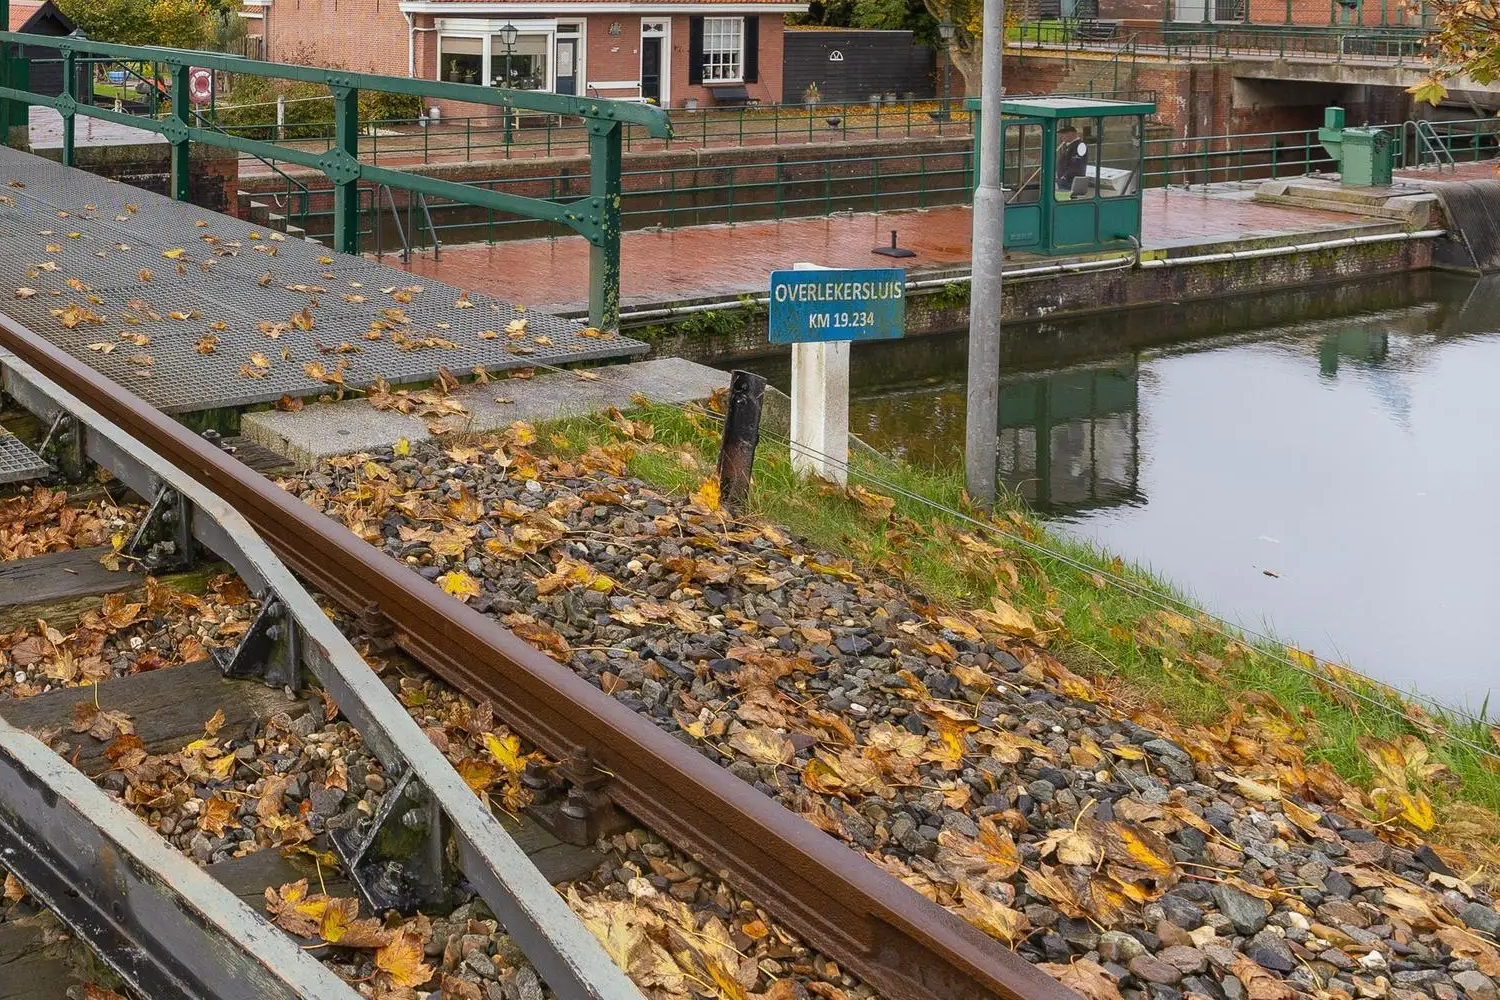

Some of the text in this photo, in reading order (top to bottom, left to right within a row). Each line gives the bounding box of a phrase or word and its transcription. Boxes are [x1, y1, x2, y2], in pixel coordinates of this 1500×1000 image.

[775, 282, 902, 302] OVERLEKERSLUIS
[809, 312, 874, 328] KM 19.234
